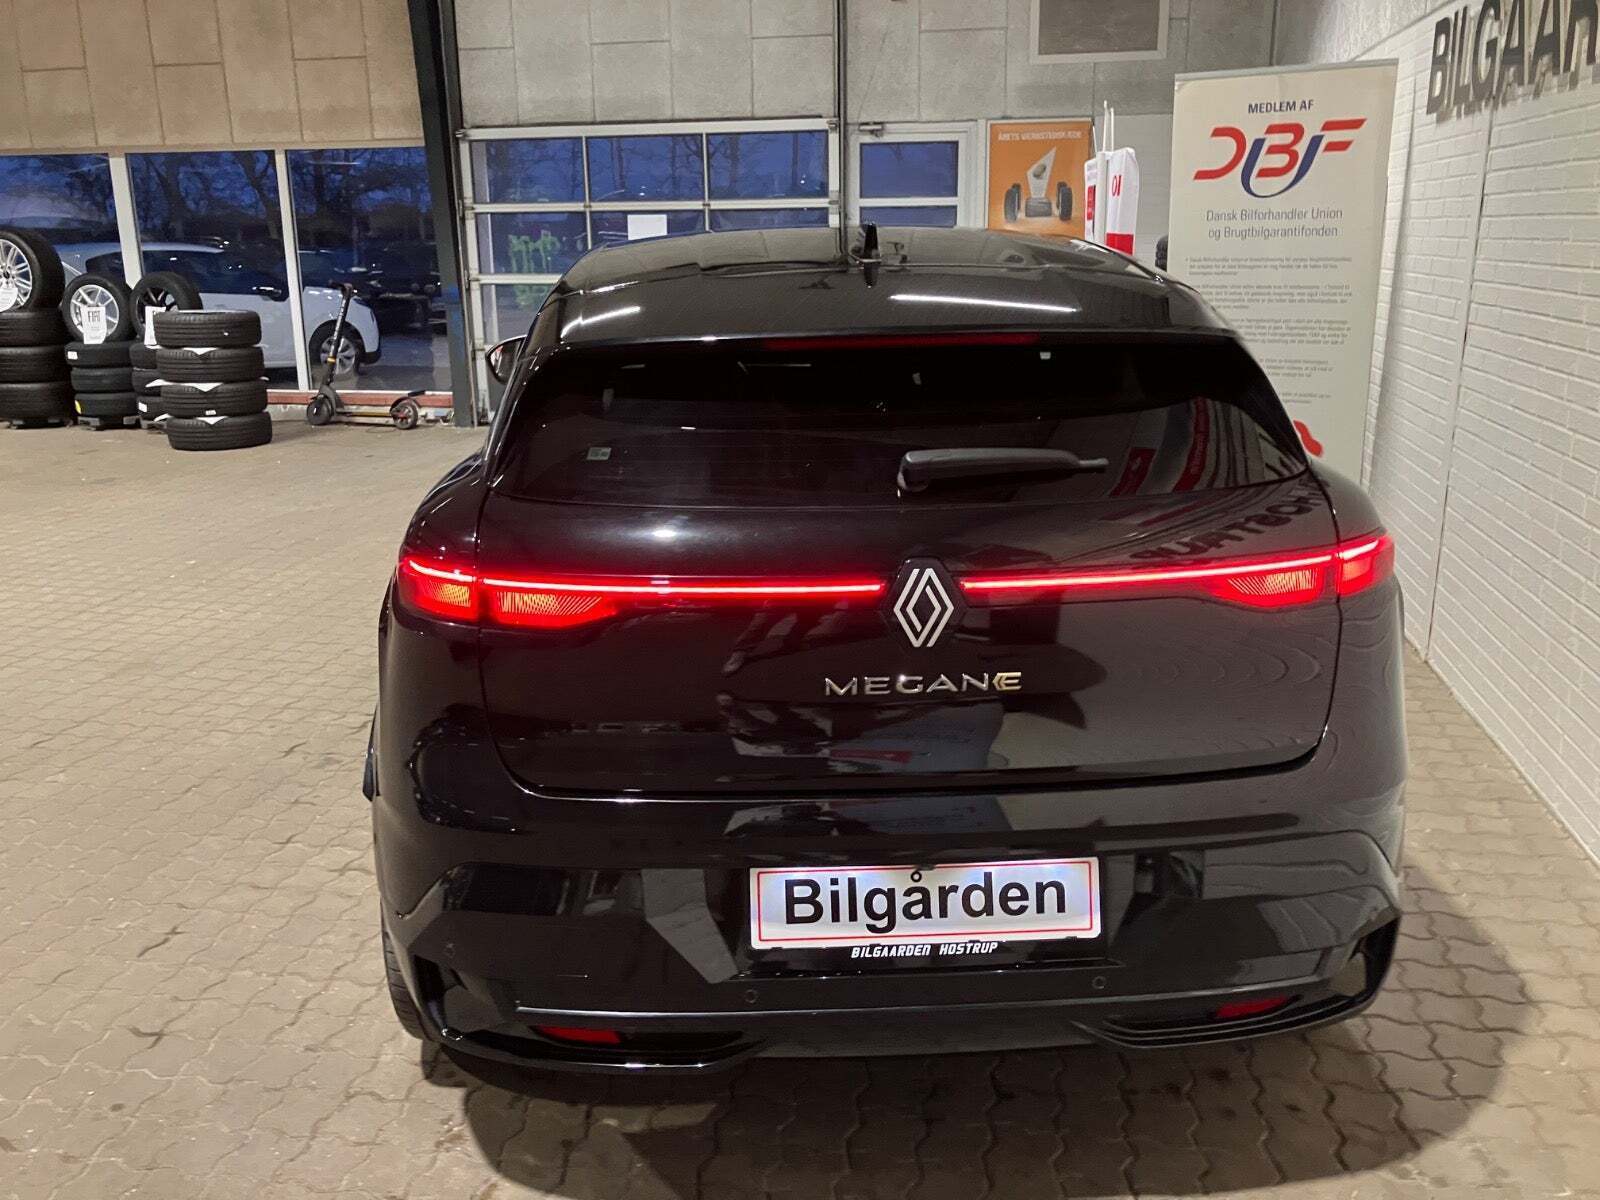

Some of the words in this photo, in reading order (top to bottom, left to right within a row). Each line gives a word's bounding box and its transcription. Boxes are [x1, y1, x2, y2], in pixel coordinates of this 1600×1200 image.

[1248, 101, 1296, 113] MEDLEM
[1300, 99, 1314, 111] AF
[1206, 209, 1237, 222] Dansk
[1240, 207, 1308, 221] Bilforhandler
[1311, 206, 1343, 220] Union
[1208, 228, 1221, 241] og
[1224, 224, 1338, 240] Brugtbilgarantifonden
[824, 671, 1023, 697] MEGANE
[784, 869, 1067, 934] Bilgården
[851, 944, 932, 959] BILGAARDEN
[938, 941, 999, 956] HOSTRUP
